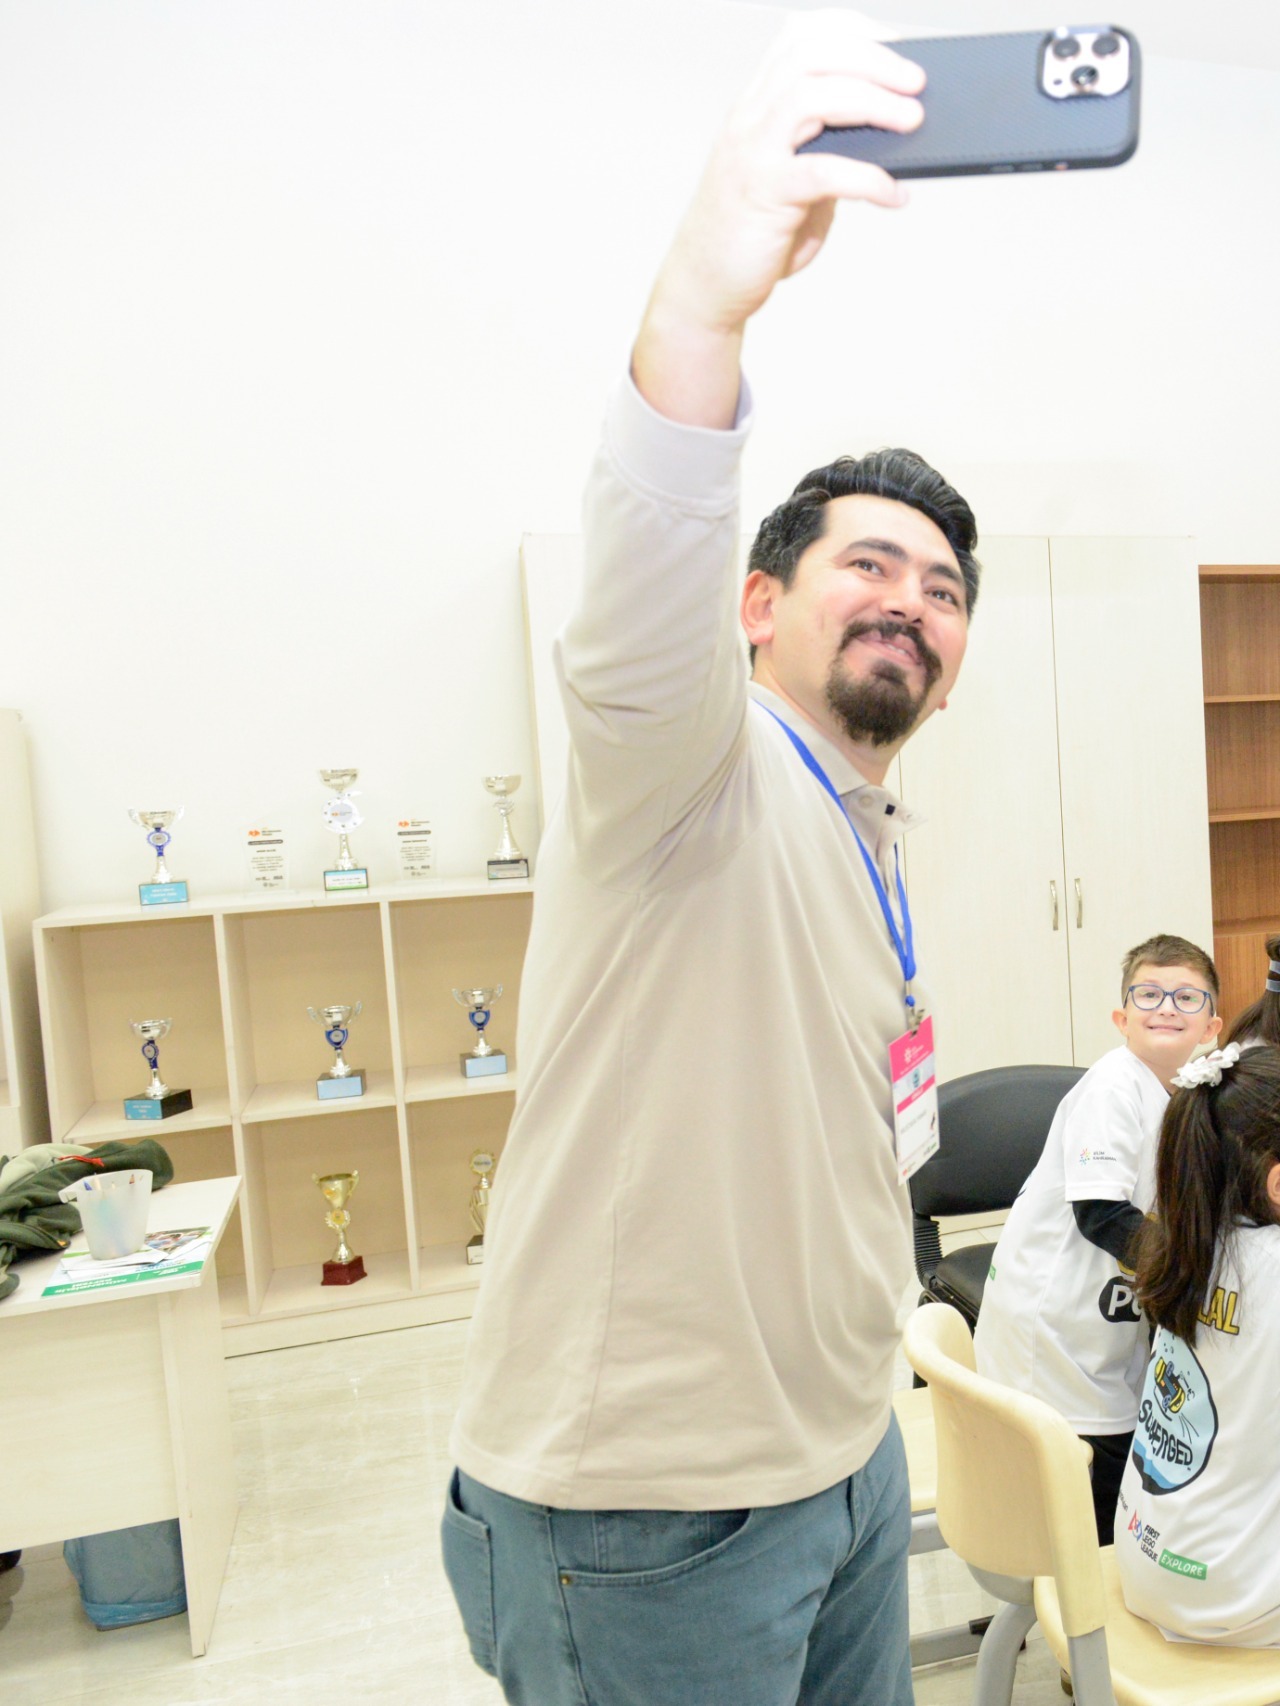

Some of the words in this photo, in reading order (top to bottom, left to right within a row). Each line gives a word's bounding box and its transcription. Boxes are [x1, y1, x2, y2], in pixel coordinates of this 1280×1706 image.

[1144, 1524, 1161, 1540] FIRST
[1142, 1533, 1156, 1549] LEGO
[1140, 1543, 1158, 1562] LEAGUE
[1160, 1553, 1204, 1577] EXPLORE
